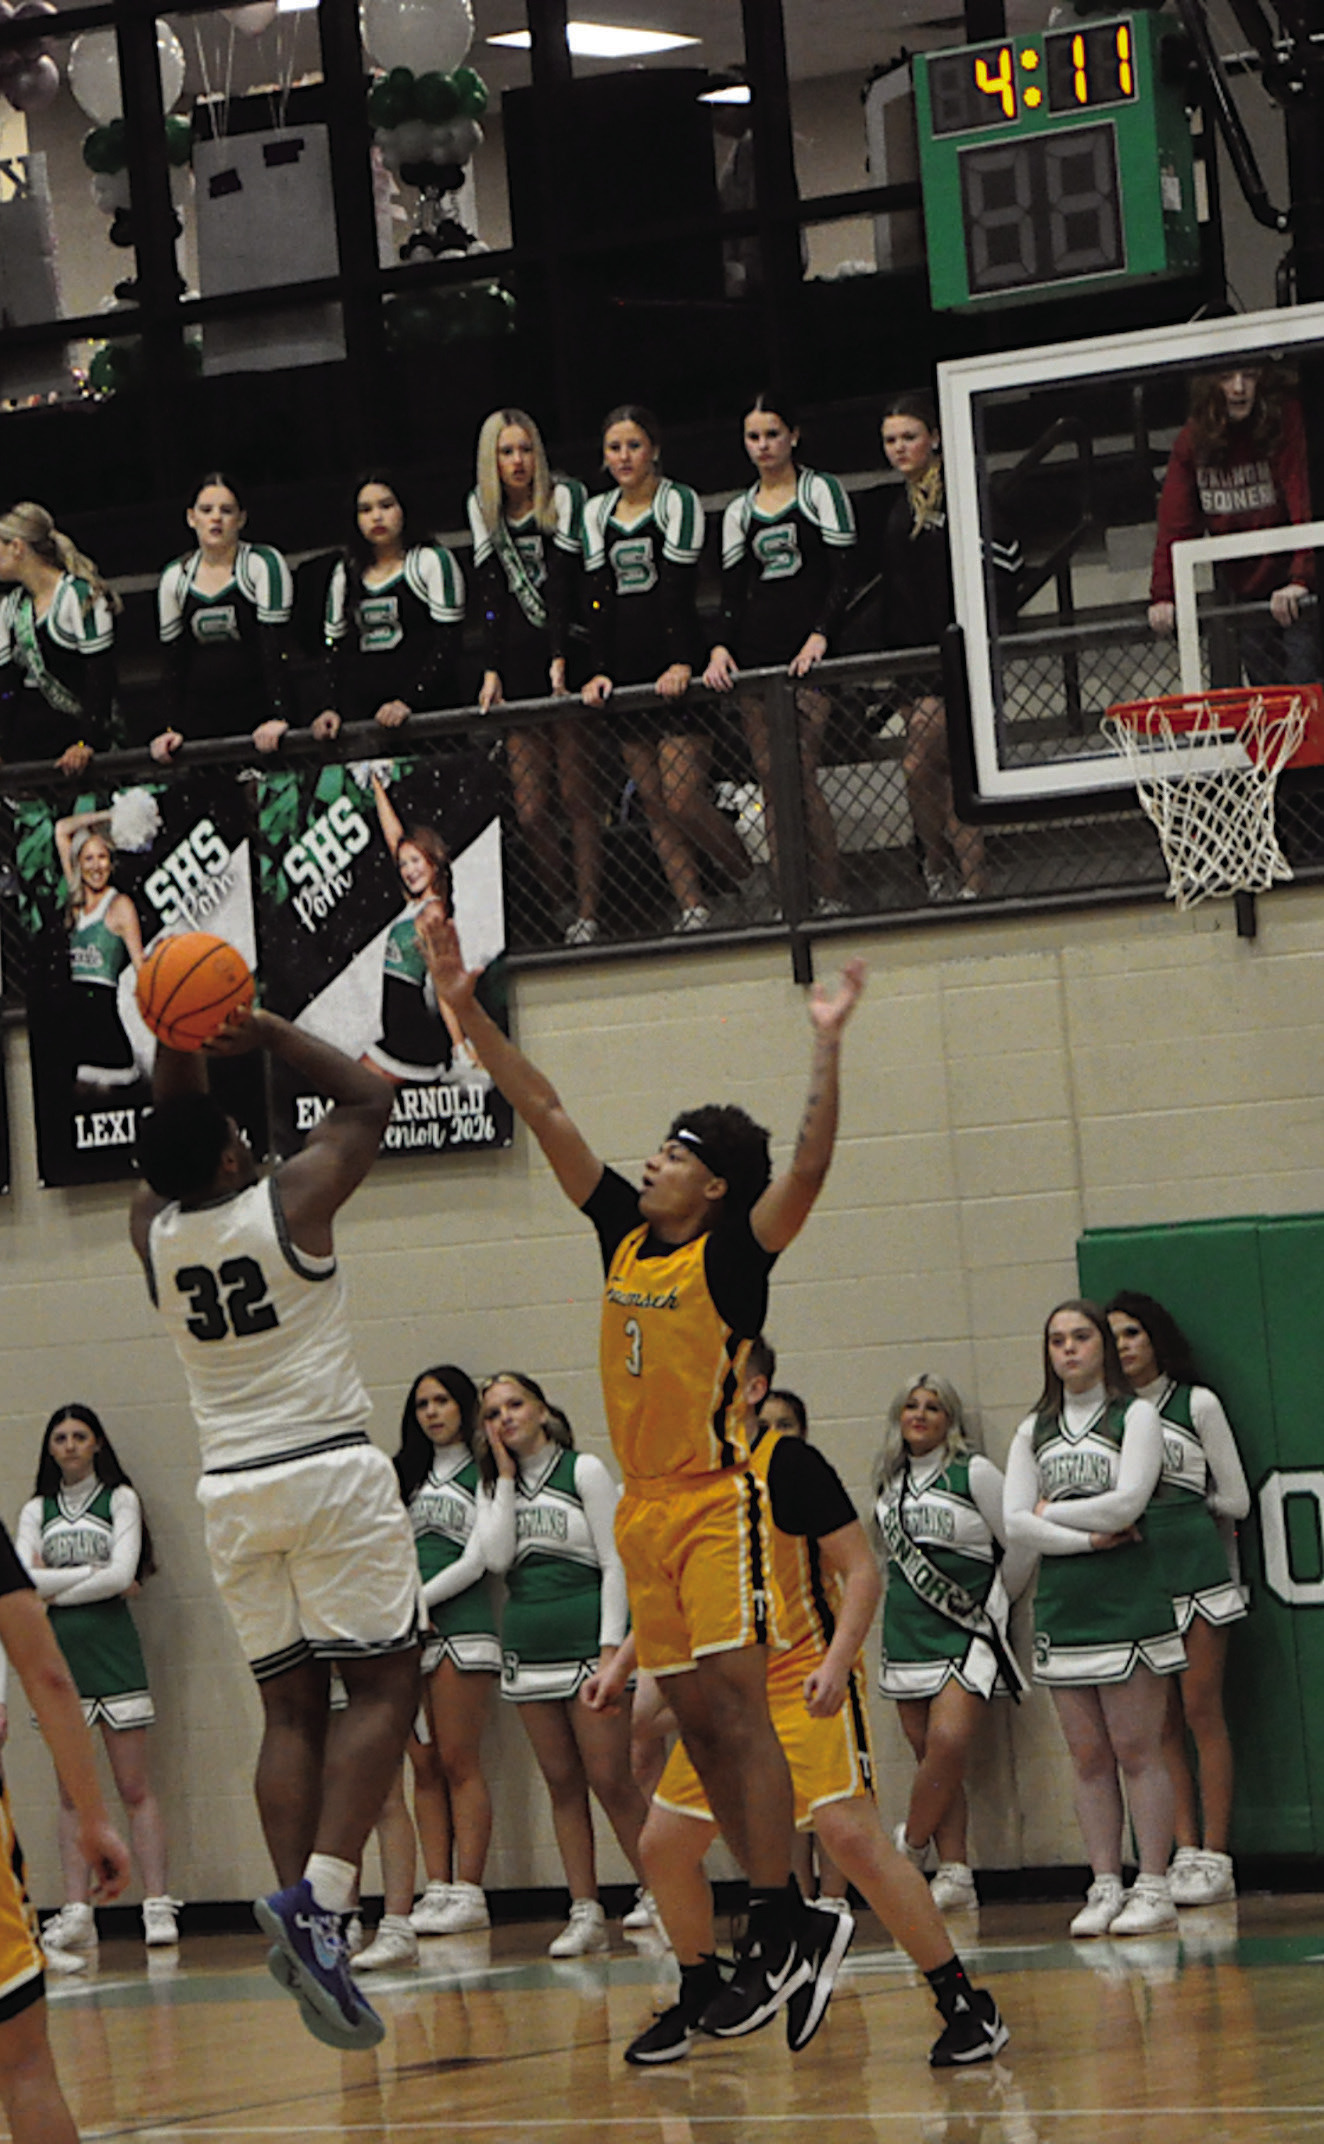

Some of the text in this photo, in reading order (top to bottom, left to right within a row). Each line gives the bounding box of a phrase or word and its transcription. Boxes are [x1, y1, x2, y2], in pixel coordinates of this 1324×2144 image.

[974, 24, 1132, 119] 4:11
[608, 536, 659, 597] S
[751, 521, 804, 582] S
[355, 596, 404, 652] S
[143, 818, 231, 925] SHS
[283, 795, 371, 896] SHS
[75, 1109, 137, 1149] LEXI
[379, 1113, 495, 1150] enior 2026
[175, 1255, 280, 1341] 32
[624, 1317, 643, 1377] 3
